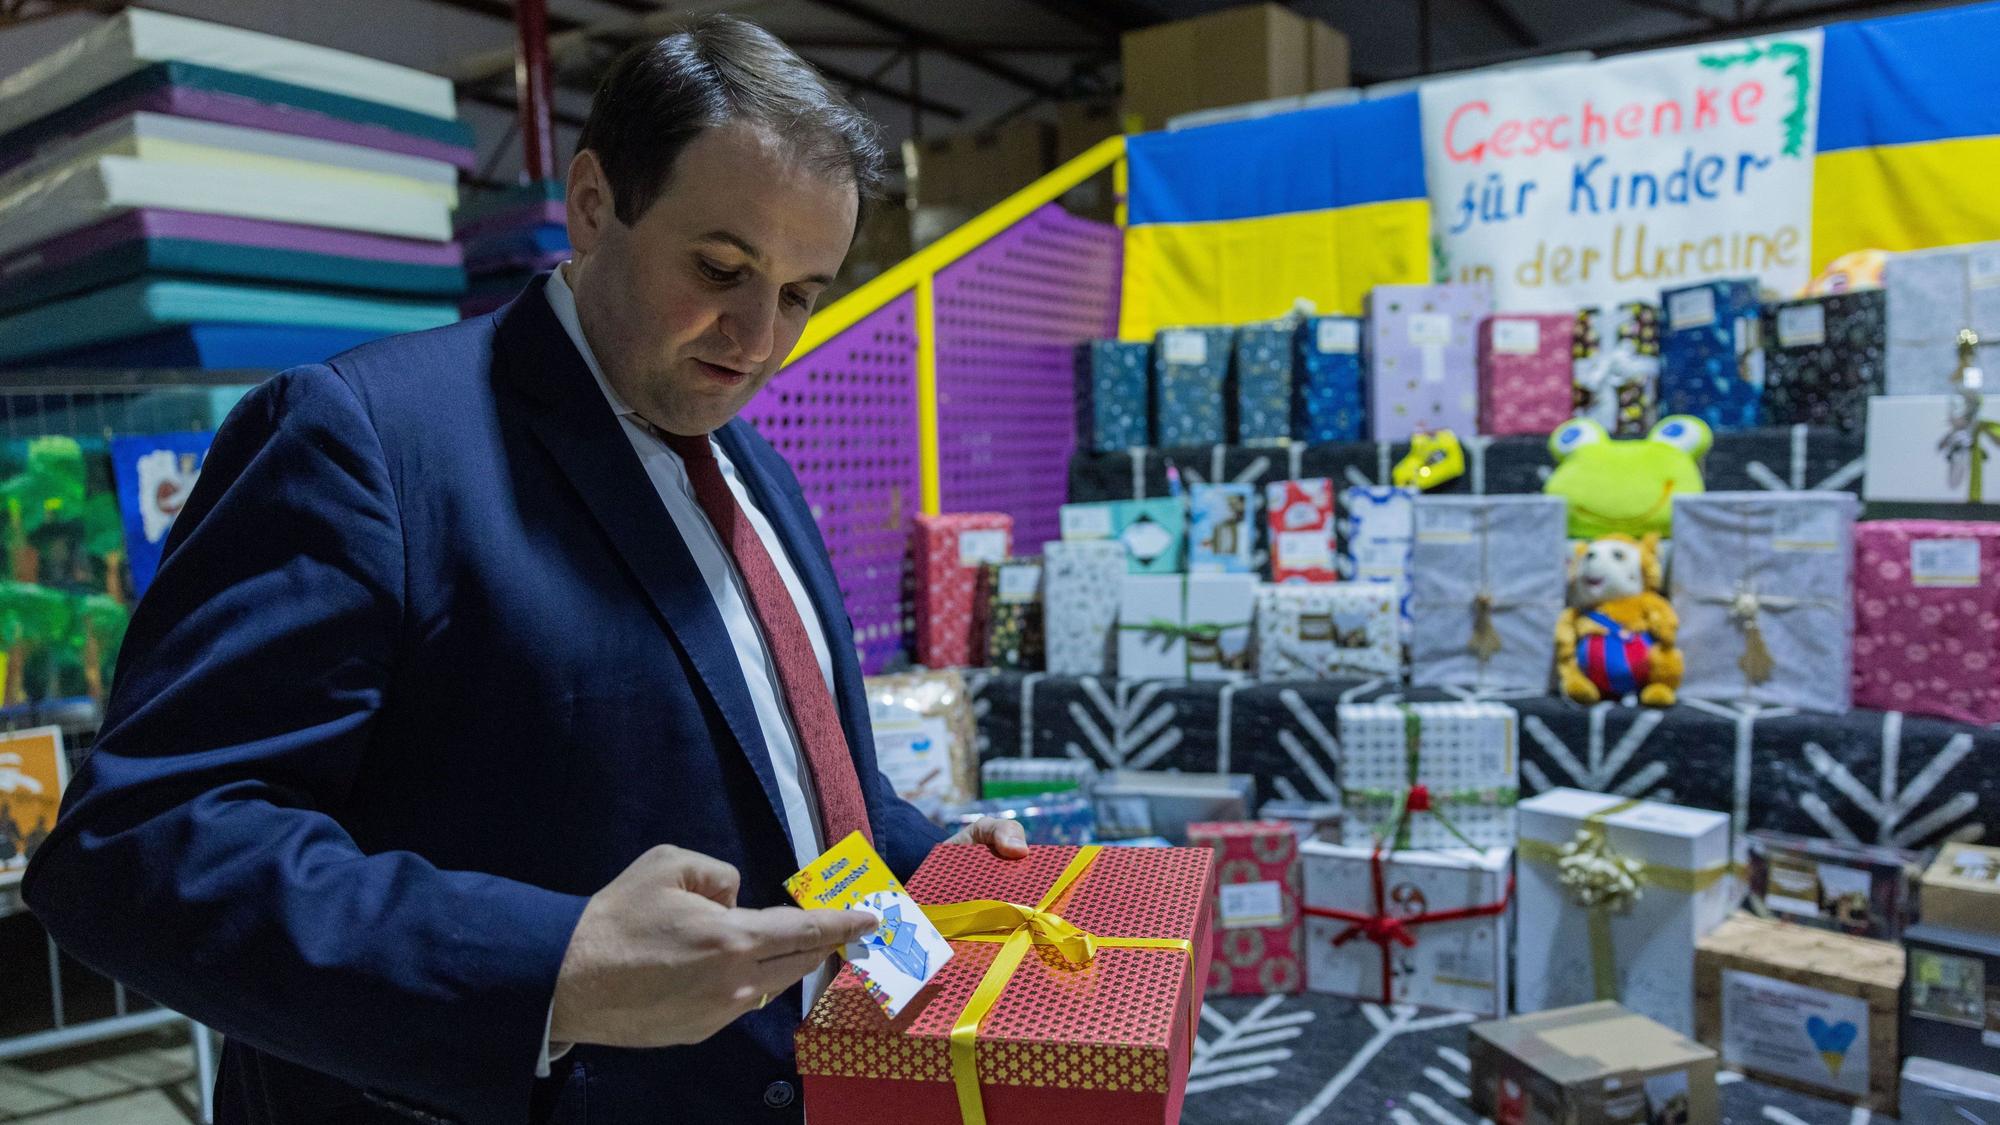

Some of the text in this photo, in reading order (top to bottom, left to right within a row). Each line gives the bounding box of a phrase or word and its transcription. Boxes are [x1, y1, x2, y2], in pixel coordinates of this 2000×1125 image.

[1443, 80, 1766, 164] Geschenke
[1447, 146, 1771, 235] für Kinder
[1460, 224, 1800, 288] in der Ukraine
[820, 857, 849, 881] Aktion
